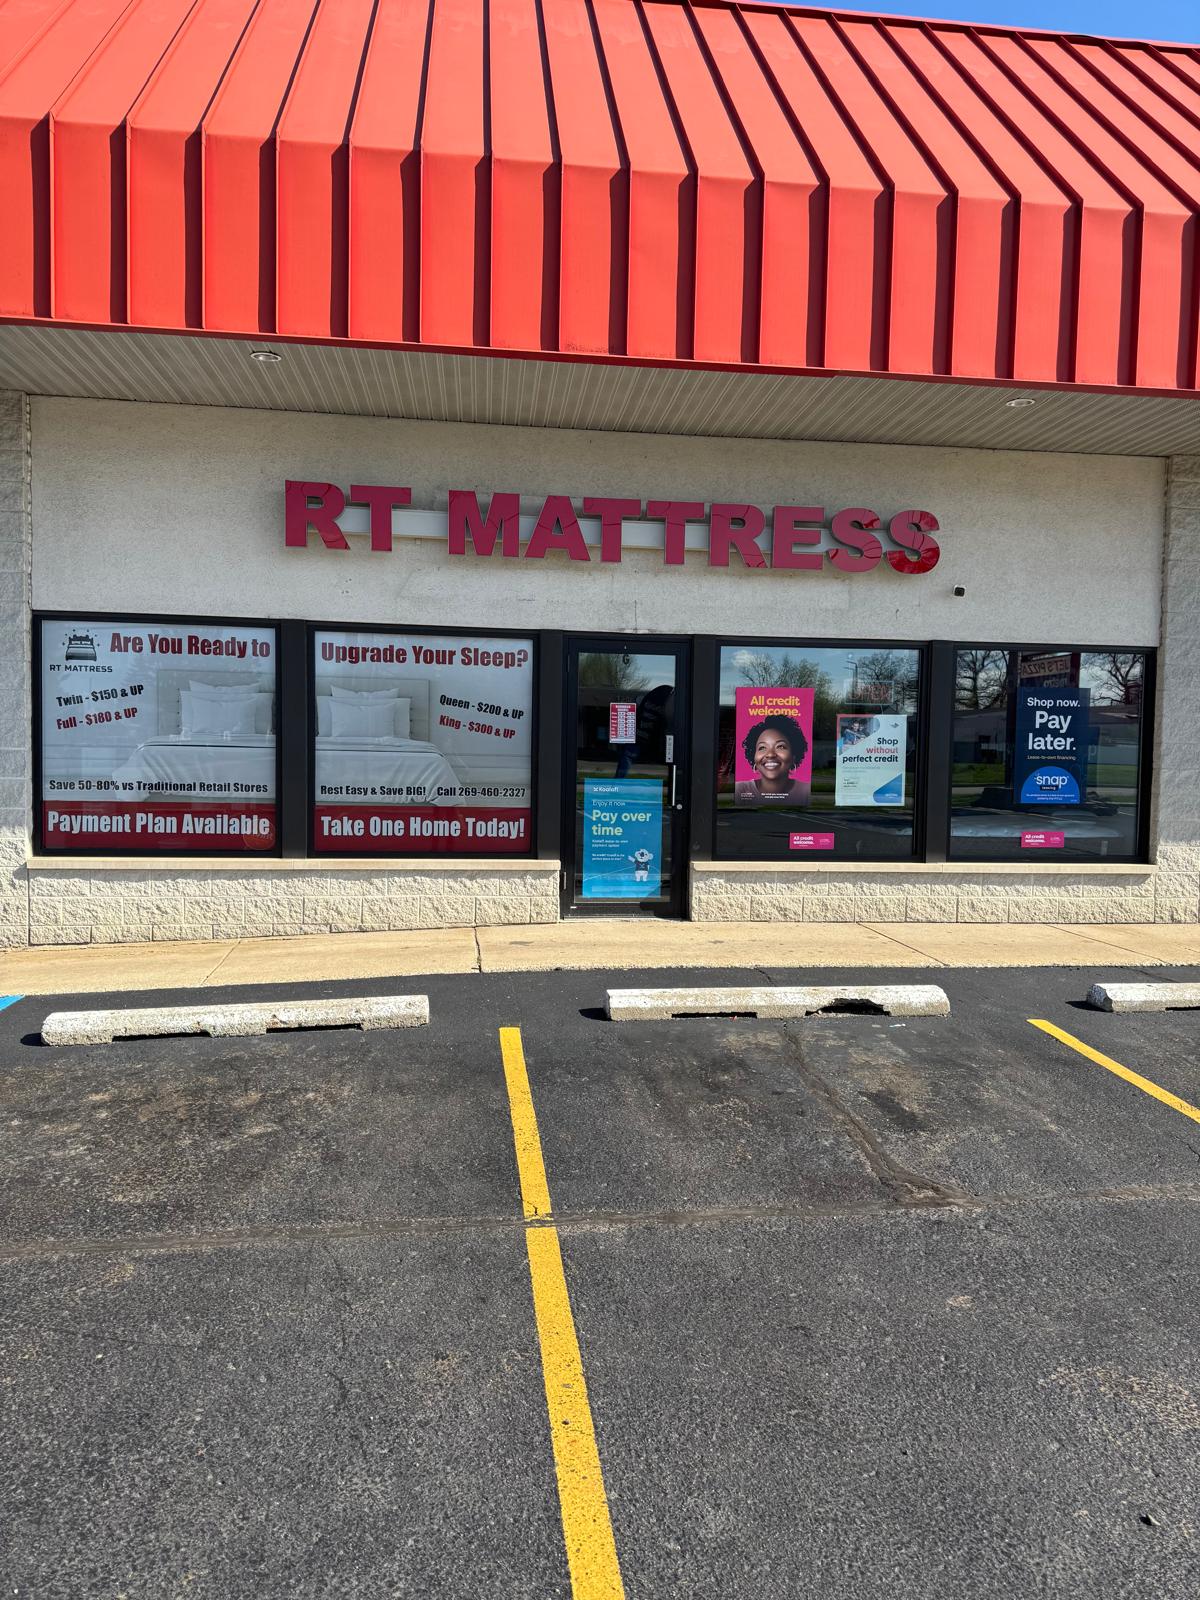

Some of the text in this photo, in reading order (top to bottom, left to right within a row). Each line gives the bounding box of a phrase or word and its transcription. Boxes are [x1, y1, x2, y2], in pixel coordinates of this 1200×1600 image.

[285, 480, 941, 575] RT MATTRESS
[110, 633, 271, 658] Are You Ready to
[321, 642, 529, 669] Upgrade Your Sleep?
[56, 693, 83, 707] Twin
[91, 688, 118, 702] $150
[120, 688, 128, 697] &
[130, 685, 144, 696] UP
[750, 696, 800, 706] All credit
[1027, 697, 1080, 709] Shop now.
[440, 695, 470, 710] Queen
[477, 702, 501, 716] $200
[503, 709, 509, 717] &
[511, 709, 524, 720] UP
[749, 706, 801, 716] welcome.
[57, 717, 77, 730] Full
[85, 712, 112, 725] $180
[114, 711, 122, 720] &
[124, 708, 138, 718] UP
[439, 715, 461, 730] King
[468, 722, 492, 735] $300
[495, 728, 501, 737] &
[503, 728, 516, 739] UP
[1035, 711, 1072, 734] Pay
[877, 738, 898, 746] Shop
[1028, 733, 1076, 751] later.
[843, 755, 872, 763] perfect
[49, 780, 268, 792] Save 50-80% vs Traditional Retail Stores
[321, 785, 526, 797] Rest Easy & Save BIG! Call 269-460-2327
[1036, 776, 1068, 788] snap
[48, 812, 270, 835] Payment Plan Available
[592, 810, 651, 823] Pay over
[321, 816, 525, 839] Take One Home Today!
[592, 824, 623, 835] time
